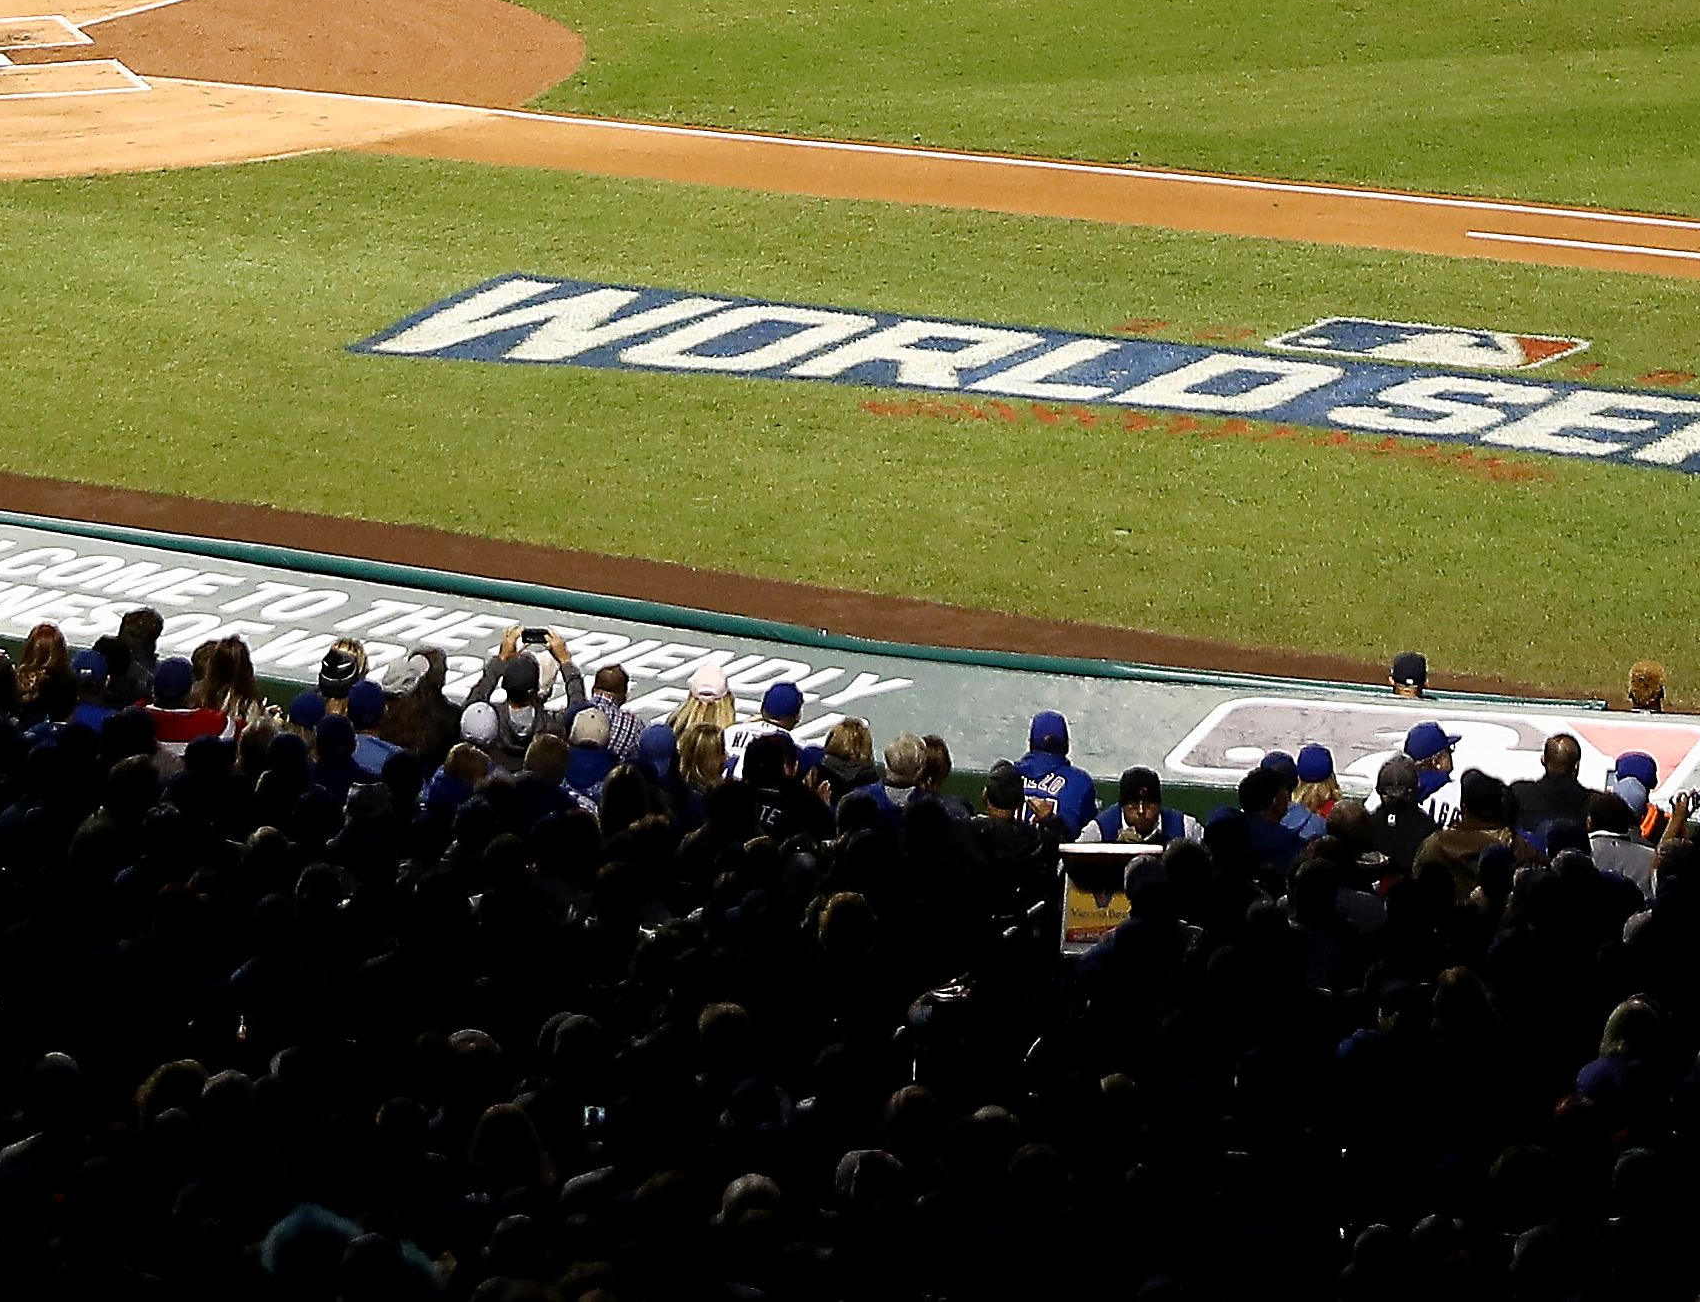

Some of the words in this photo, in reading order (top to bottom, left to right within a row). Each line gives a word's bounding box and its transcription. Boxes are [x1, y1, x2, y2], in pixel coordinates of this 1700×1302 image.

[372, 280, 1328, 419] WORLD
[218, 582, 350, 624] TO
[334, 600, 521, 651] THE
